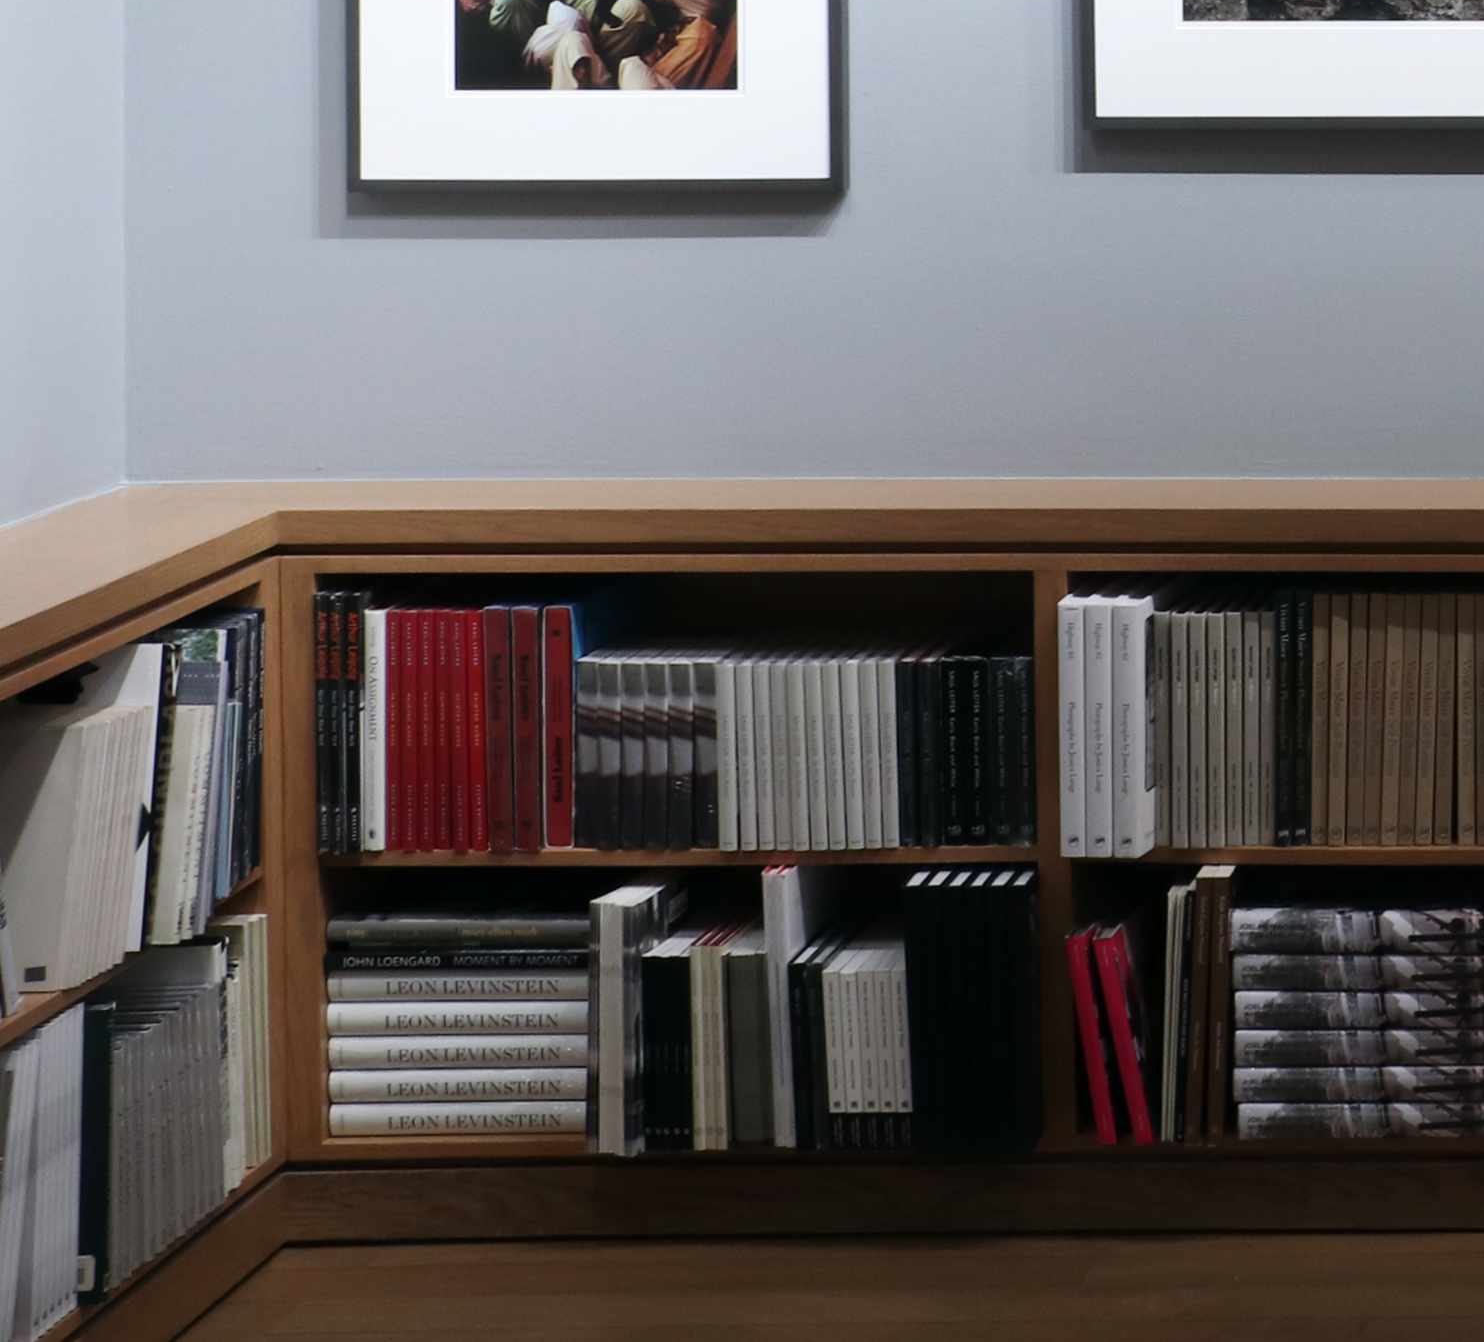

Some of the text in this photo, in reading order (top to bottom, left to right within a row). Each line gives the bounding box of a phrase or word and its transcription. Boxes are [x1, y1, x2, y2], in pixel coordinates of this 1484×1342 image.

[345, 612, 358, 680] Arthur Leipzig
[344, 956, 442, 968] JOHN LOENGARD
[453, 956, 578, 966] MOMENT BY MOMENT
[386, 980, 559, 994] LEON LEVINSTEIN
[385, 1014, 558, 1029] LEON LEVINSTEIN
[387, 1048, 560, 1063] LEON LEVINSTEIN
[387, 1081, 560, 1096] LEON LEVINSTEIN
[388, 1114, 562, 1130] LEON LEVINSTEIN
